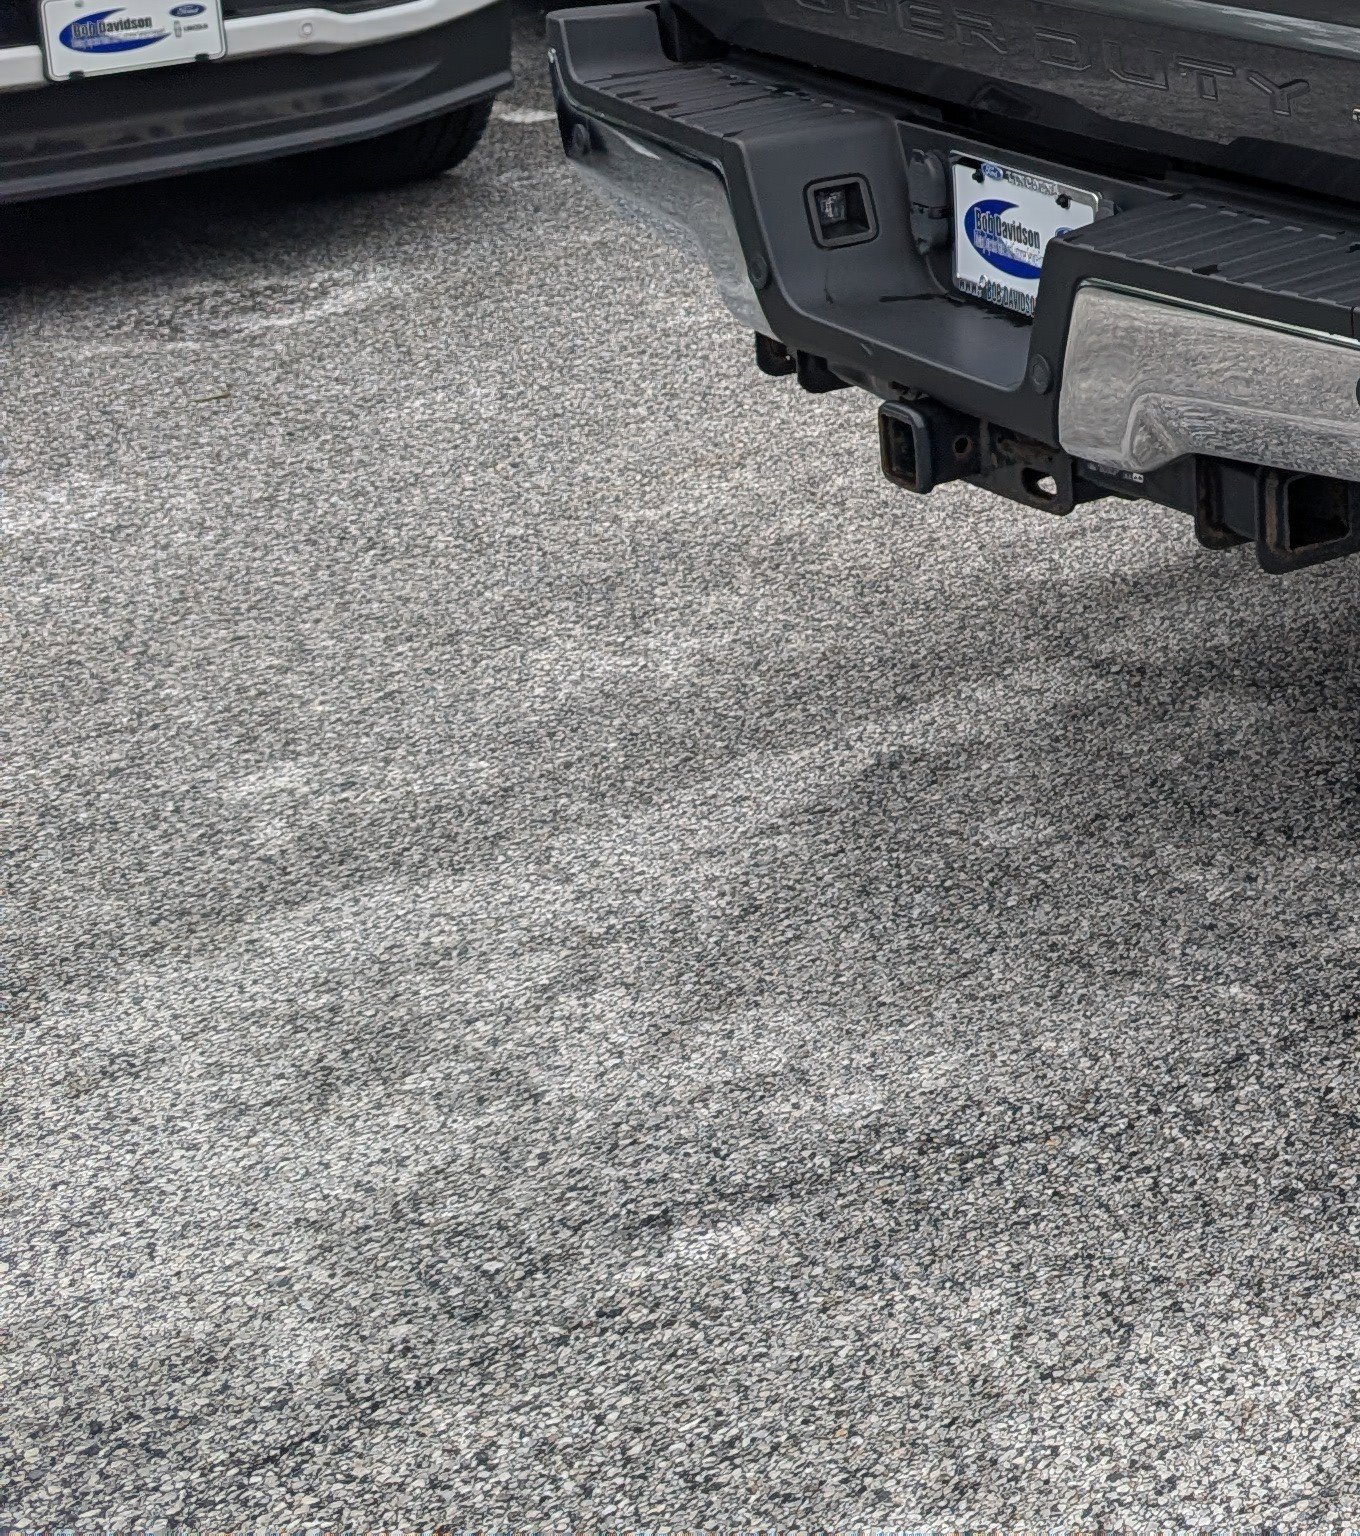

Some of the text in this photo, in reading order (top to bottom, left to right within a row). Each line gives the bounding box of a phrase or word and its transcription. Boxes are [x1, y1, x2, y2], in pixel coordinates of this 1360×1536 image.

[72, 16, 153, 39] Bob Davidson
[1034, 23, 1310, 117] DUTY
[974, 207, 994, 234] Bob
[994, 213, 1041, 250] Davidson
